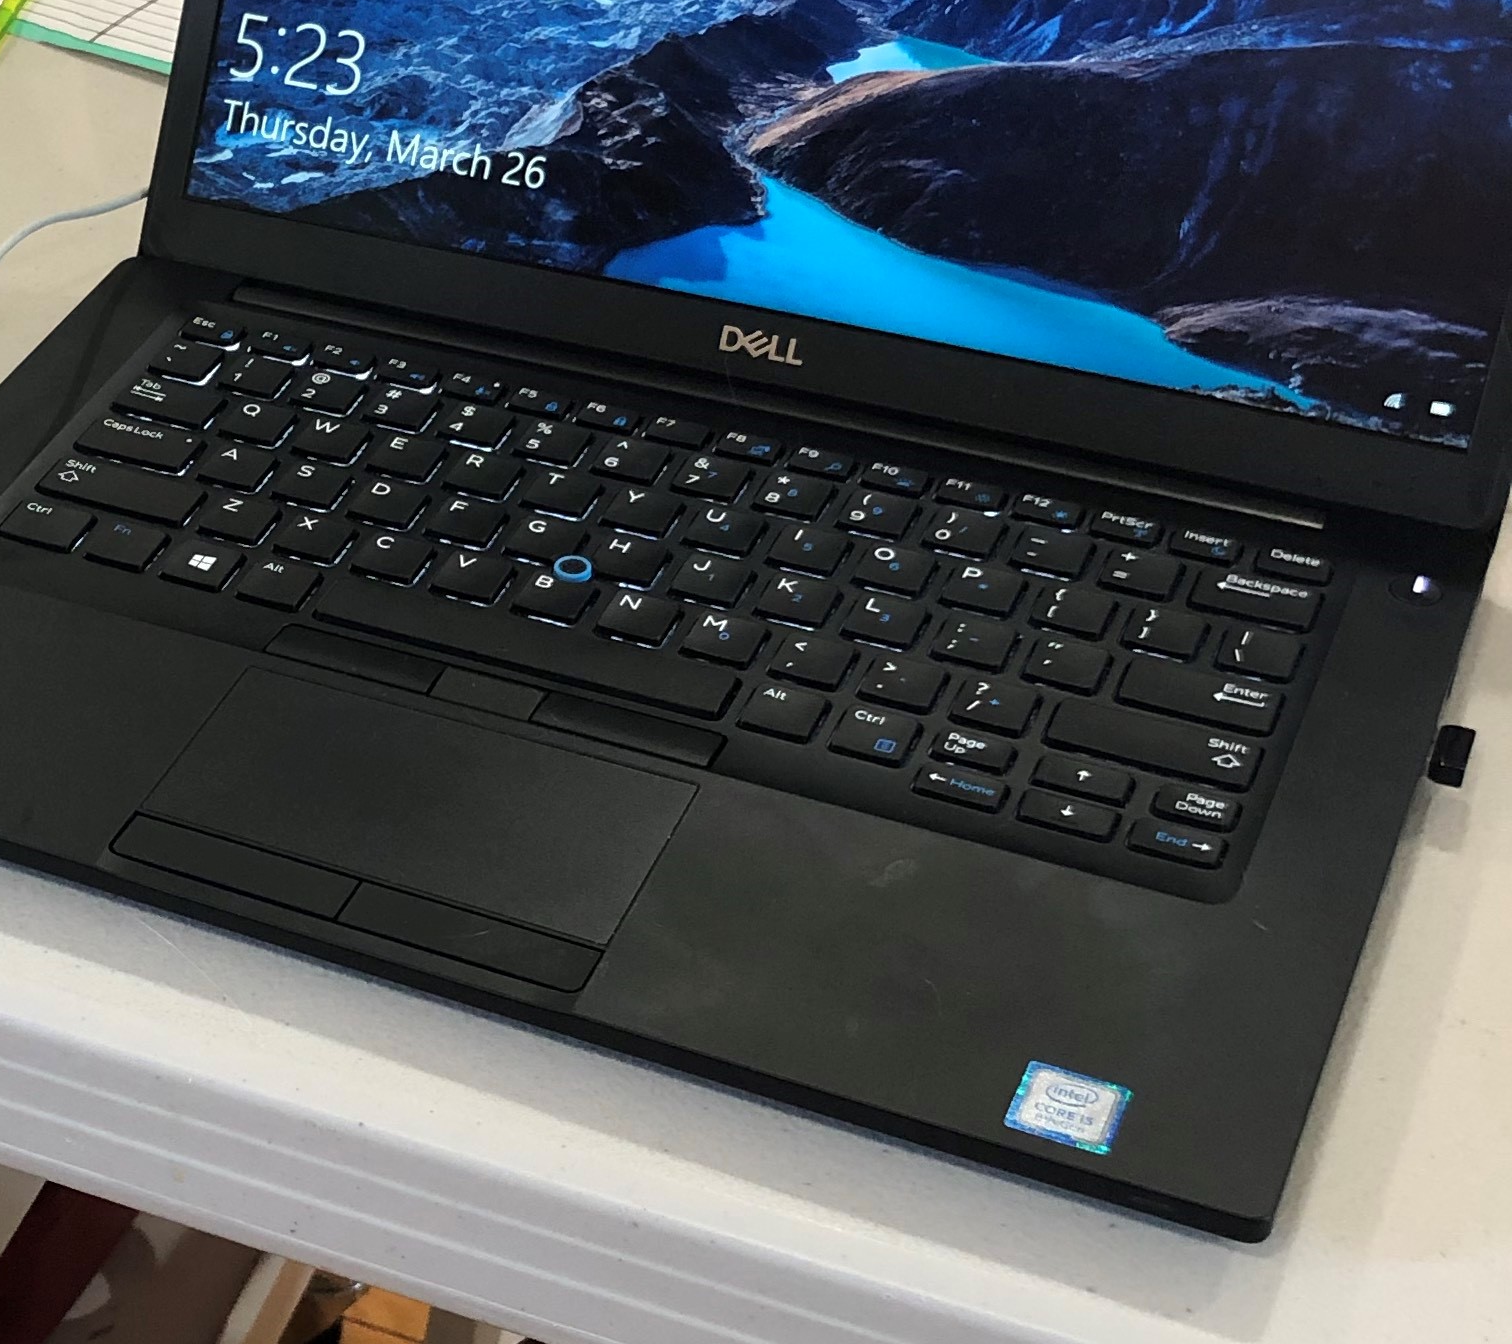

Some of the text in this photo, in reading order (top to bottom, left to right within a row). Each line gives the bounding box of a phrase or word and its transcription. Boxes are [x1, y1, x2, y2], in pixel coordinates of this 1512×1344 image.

[229, 12, 365, 96] 5:23
[223, 98, 547, 190] Thursday, March 26
[193, 316, 216, 329] Esc
[262, 331, 279, 341] F1
[324, 344, 343, 354] F2
[719, 324, 803, 366] DELL
[388, 358, 407, 369] F3
[233, 373, 242, 382] 1
[452, 372, 472, 384] F4
[141, 379, 161, 390] Tab
[301, 388, 316, 399] 2
[519, 387, 538, 399] F5
[243, 404, 261, 417] Q
[374, 404, 388, 415] 3
[461, 405, 476, 417] $
[587, 402, 606, 413] F6
[315, 419, 340, 433] W
[449, 422, 464, 432] 4
[656, 417, 676, 427] F7
[103, 419, 164, 440] Caps Lock
[390, 437, 409, 450] E
[726, 432, 747, 443] F8
[526, 439, 540, 450] 5
[221, 449, 238, 460] A
[798, 446, 819, 458] F9
[65, 459, 97, 474] Shift
[465, 454, 485, 468] R
[604, 456, 620, 467] 6
[297, 465, 316, 478] S
[871, 462, 899, 476] F10
[549, 472, 565, 485] T
[685, 474, 700, 484] 7
[946, 478, 972, 491] F11
[371, 482, 391, 495] D
[629, 489, 645, 503] Y
[765, 492, 780, 503] 8
[1022, 494, 1051, 507] F12
[26, 502, 53, 515] Ctrl
[222, 498, 244, 512] Z
[449, 500, 469, 512] F
[706, 509, 727, 523] U
[849, 510, 866, 521] 9
[1101, 510, 1154, 529] PrtScr
[113, 524, 132, 535] Fn
[297, 516, 319, 531] X
[528, 520, 548, 533] G
[794, 529, 803, 541] I
[1184, 530, 1230, 547] Insert
[376, 536, 395, 549] C
[609, 538, 632, 553] H
[874, 547, 896, 561] O
[1271, 549, 1321, 567] Delete
[459, 554, 477, 568] V
[693, 560, 711, 571] J
[262, 562, 284, 574] Alt
[962, 567, 983, 579] P
[535, 575, 554, 589] B
[777, 578, 799, 593] K
[1226, 573, 1309, 598] Backspace
[620, 595, 642, 610] N
[865, 598, 881, 613] L
[703, 615, 728, 632] M
[763, 688, 787, 701] Alt
[1223, 683, 1269, 701] Enter
[854, 710, 886, 726] Ctrl
[948, 732, 986, 750] Page
[1208, 738, 1249, 754] Shift
[944, 741, 966, 755] Up
[949, 778, 996, 796] Home
[1186, 792, 1226, 809] Page
[1175, 801, 1223, 819] Down
[1155, 831, 1187, 847] End
[1053, 1086, 1092, 1103] intel
[1035, 1102, 1076, 1122] CORE
